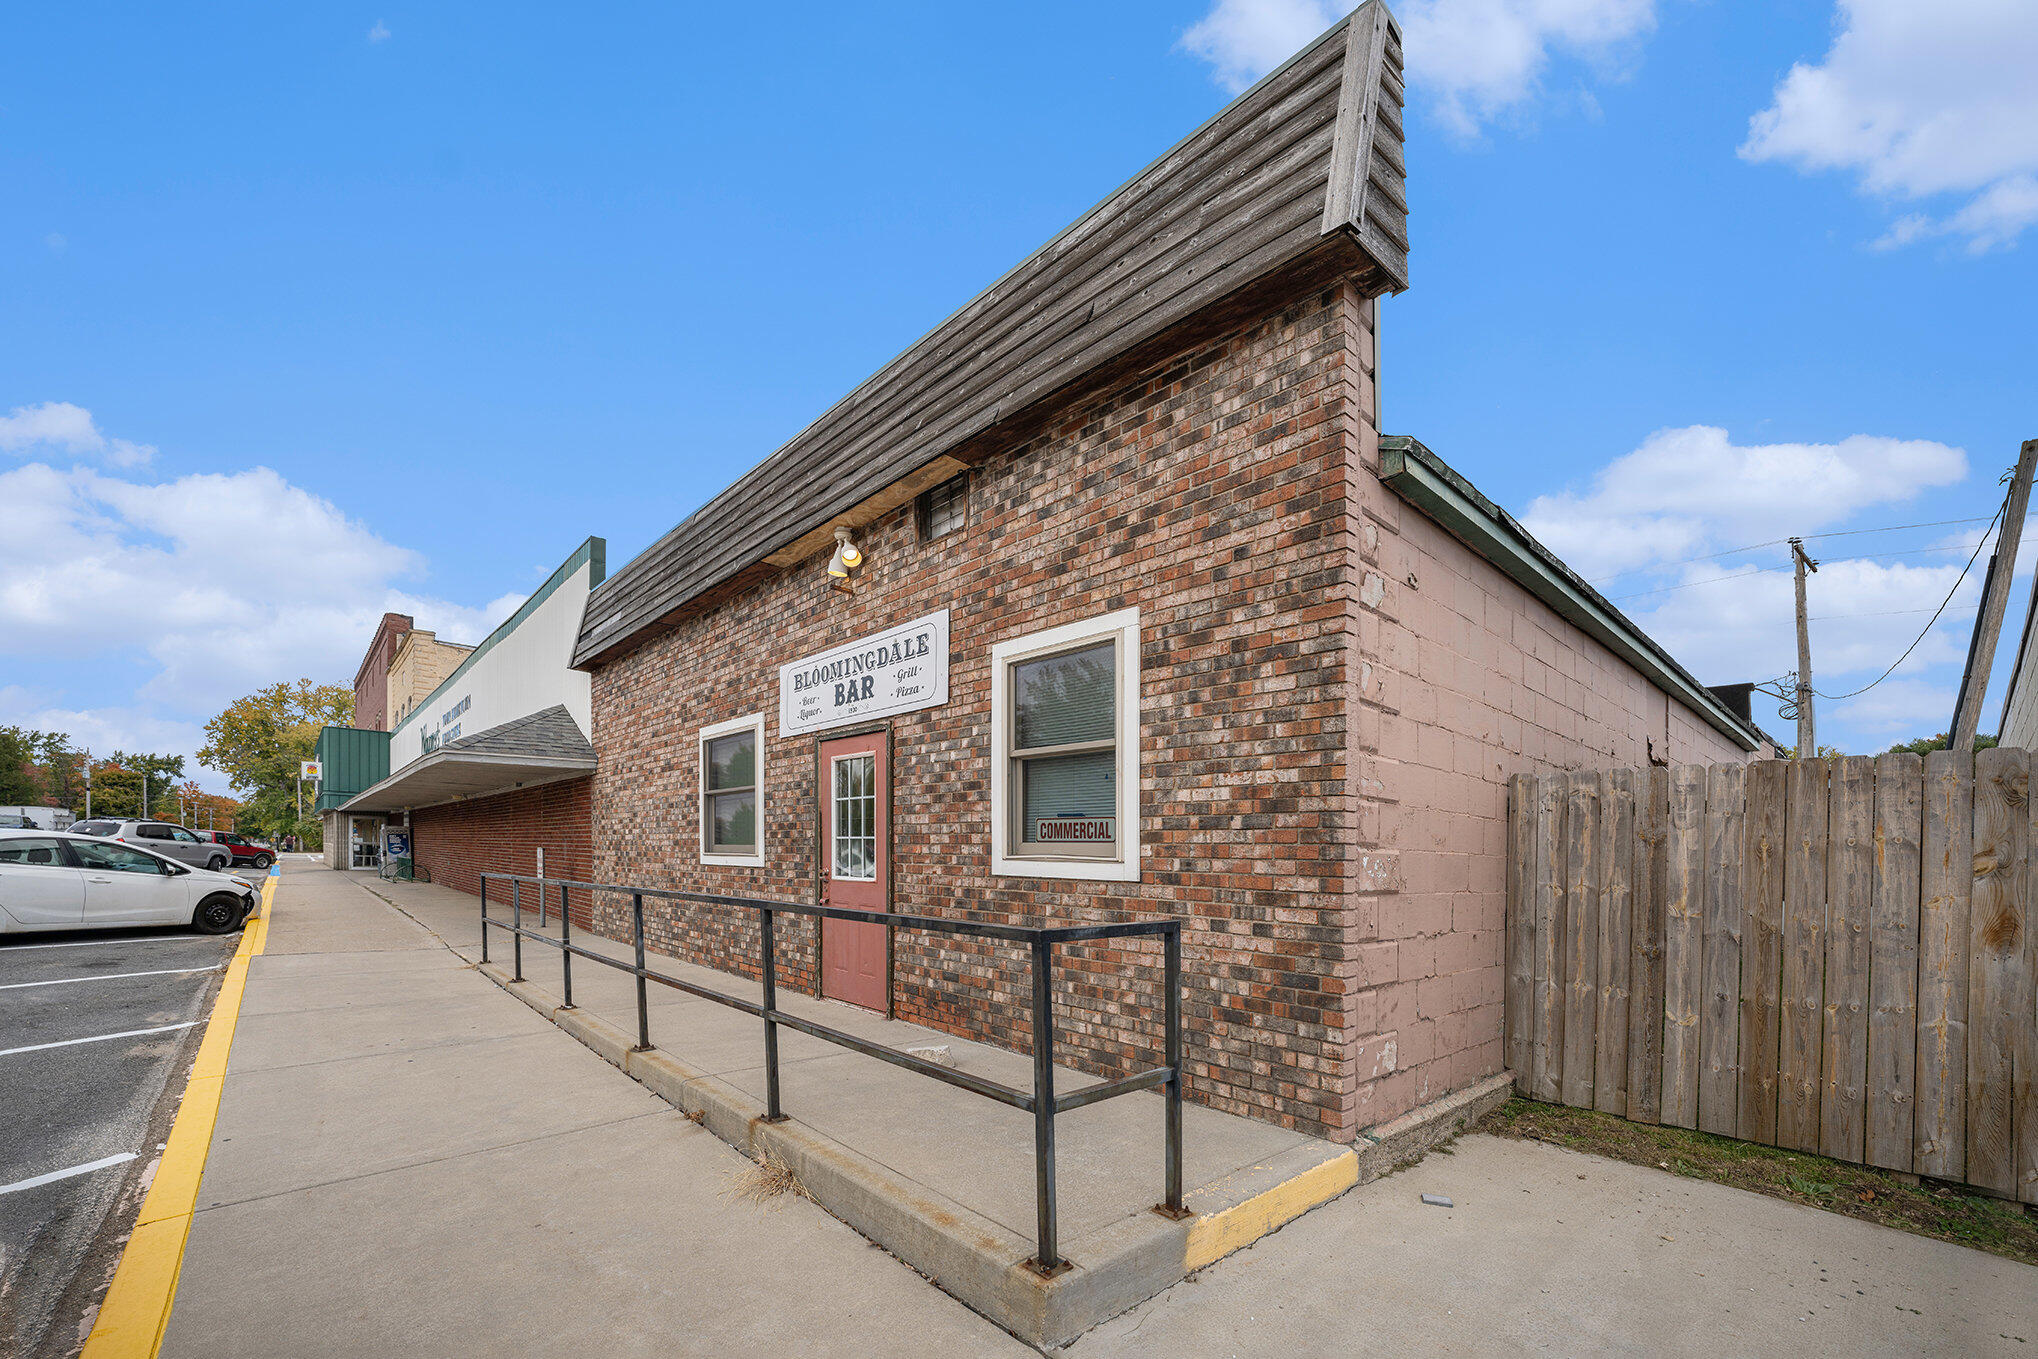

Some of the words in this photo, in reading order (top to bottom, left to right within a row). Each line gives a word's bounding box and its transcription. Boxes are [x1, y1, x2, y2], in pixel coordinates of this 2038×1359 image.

[793, 633, 930, 693] BLOOMINGDALE
[897, 665, 918, 684] Grill
[834, 675, 875, 707] BAR
[895, 685, 919, 698] Pizza
[801, 696, 817, 706] Beer
[799, 708, 820, 721] Liquor
[1040, 821, 1111, 839] COMMERCIAL
